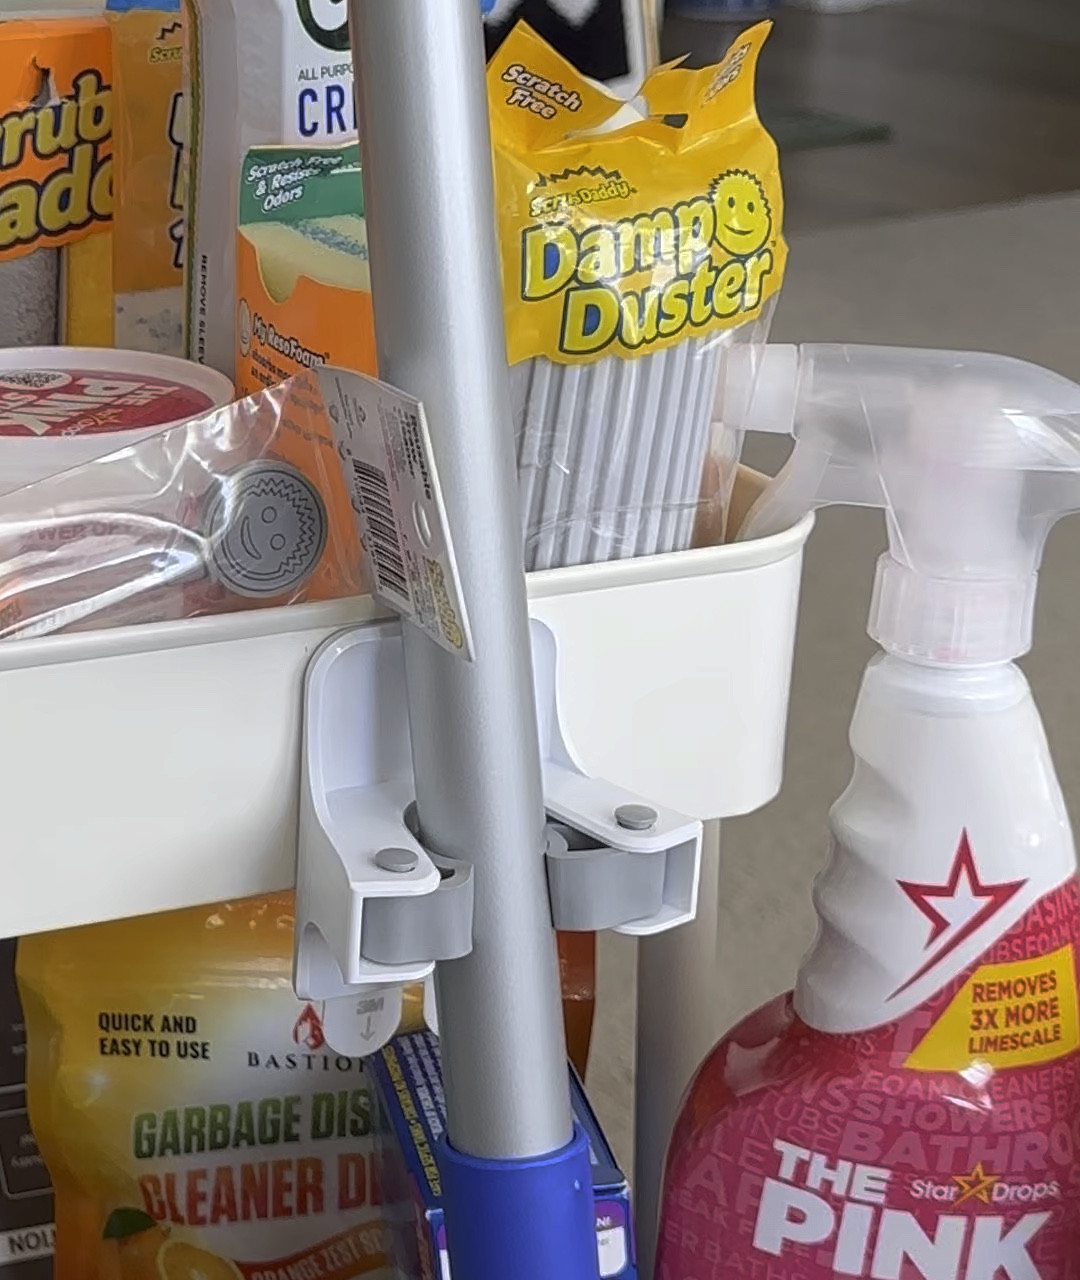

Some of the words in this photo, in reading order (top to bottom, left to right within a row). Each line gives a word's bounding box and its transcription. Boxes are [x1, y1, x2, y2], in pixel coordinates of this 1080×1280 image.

[297, 64, 318, 82] ALL
[319, 62, 355, 80] PURPO
[501, 63, 582, 111] Scratch
[298, 84, 359, 138] CR
[506, 87, 557, 120] Free
[248, 155, 302, 182] Scratch
[306, 155, 343, 170] Free
[270, 167, 322, 192] Resists
[261, 184, 304, 213] Odors
[521, 195, 717, 302] Damp
[199, 253, 209, 309] REMOVE
[559, 248, 773, 356] Duster
[197, 314, 208, 367] SLEEV
[113, 384, 180, 407] THE
[971, 968, 1058, 1005] REMOVES
[98, 1011, 155, 1034] QUICK
[160, 1015, 198, 1035] AND
[356, 996, 385, 1017] 3M
[971, 1007, 999, 1032] 3X
[1004, 996, 1061, 1029] MORE
[99, 1036, 142, 1058] EASY
[147, 1038, 171, 1059] TO
[176, 1040, 211, 1061] USE
[968, 1024, 1062, 1056] LIMESCALE
[133, 1093, 303, 1160] GARBAGE
[310, 1087, 375, 1140] DIS
[773, 1137, 893, 1204] THE
[138, 1156, 328, 1228] CLEANER
[909, 1178, 958, 1203] Star
[991, 1179, 1061, 1205] Drops
[324, 1235, 360, 1272] ZEST
